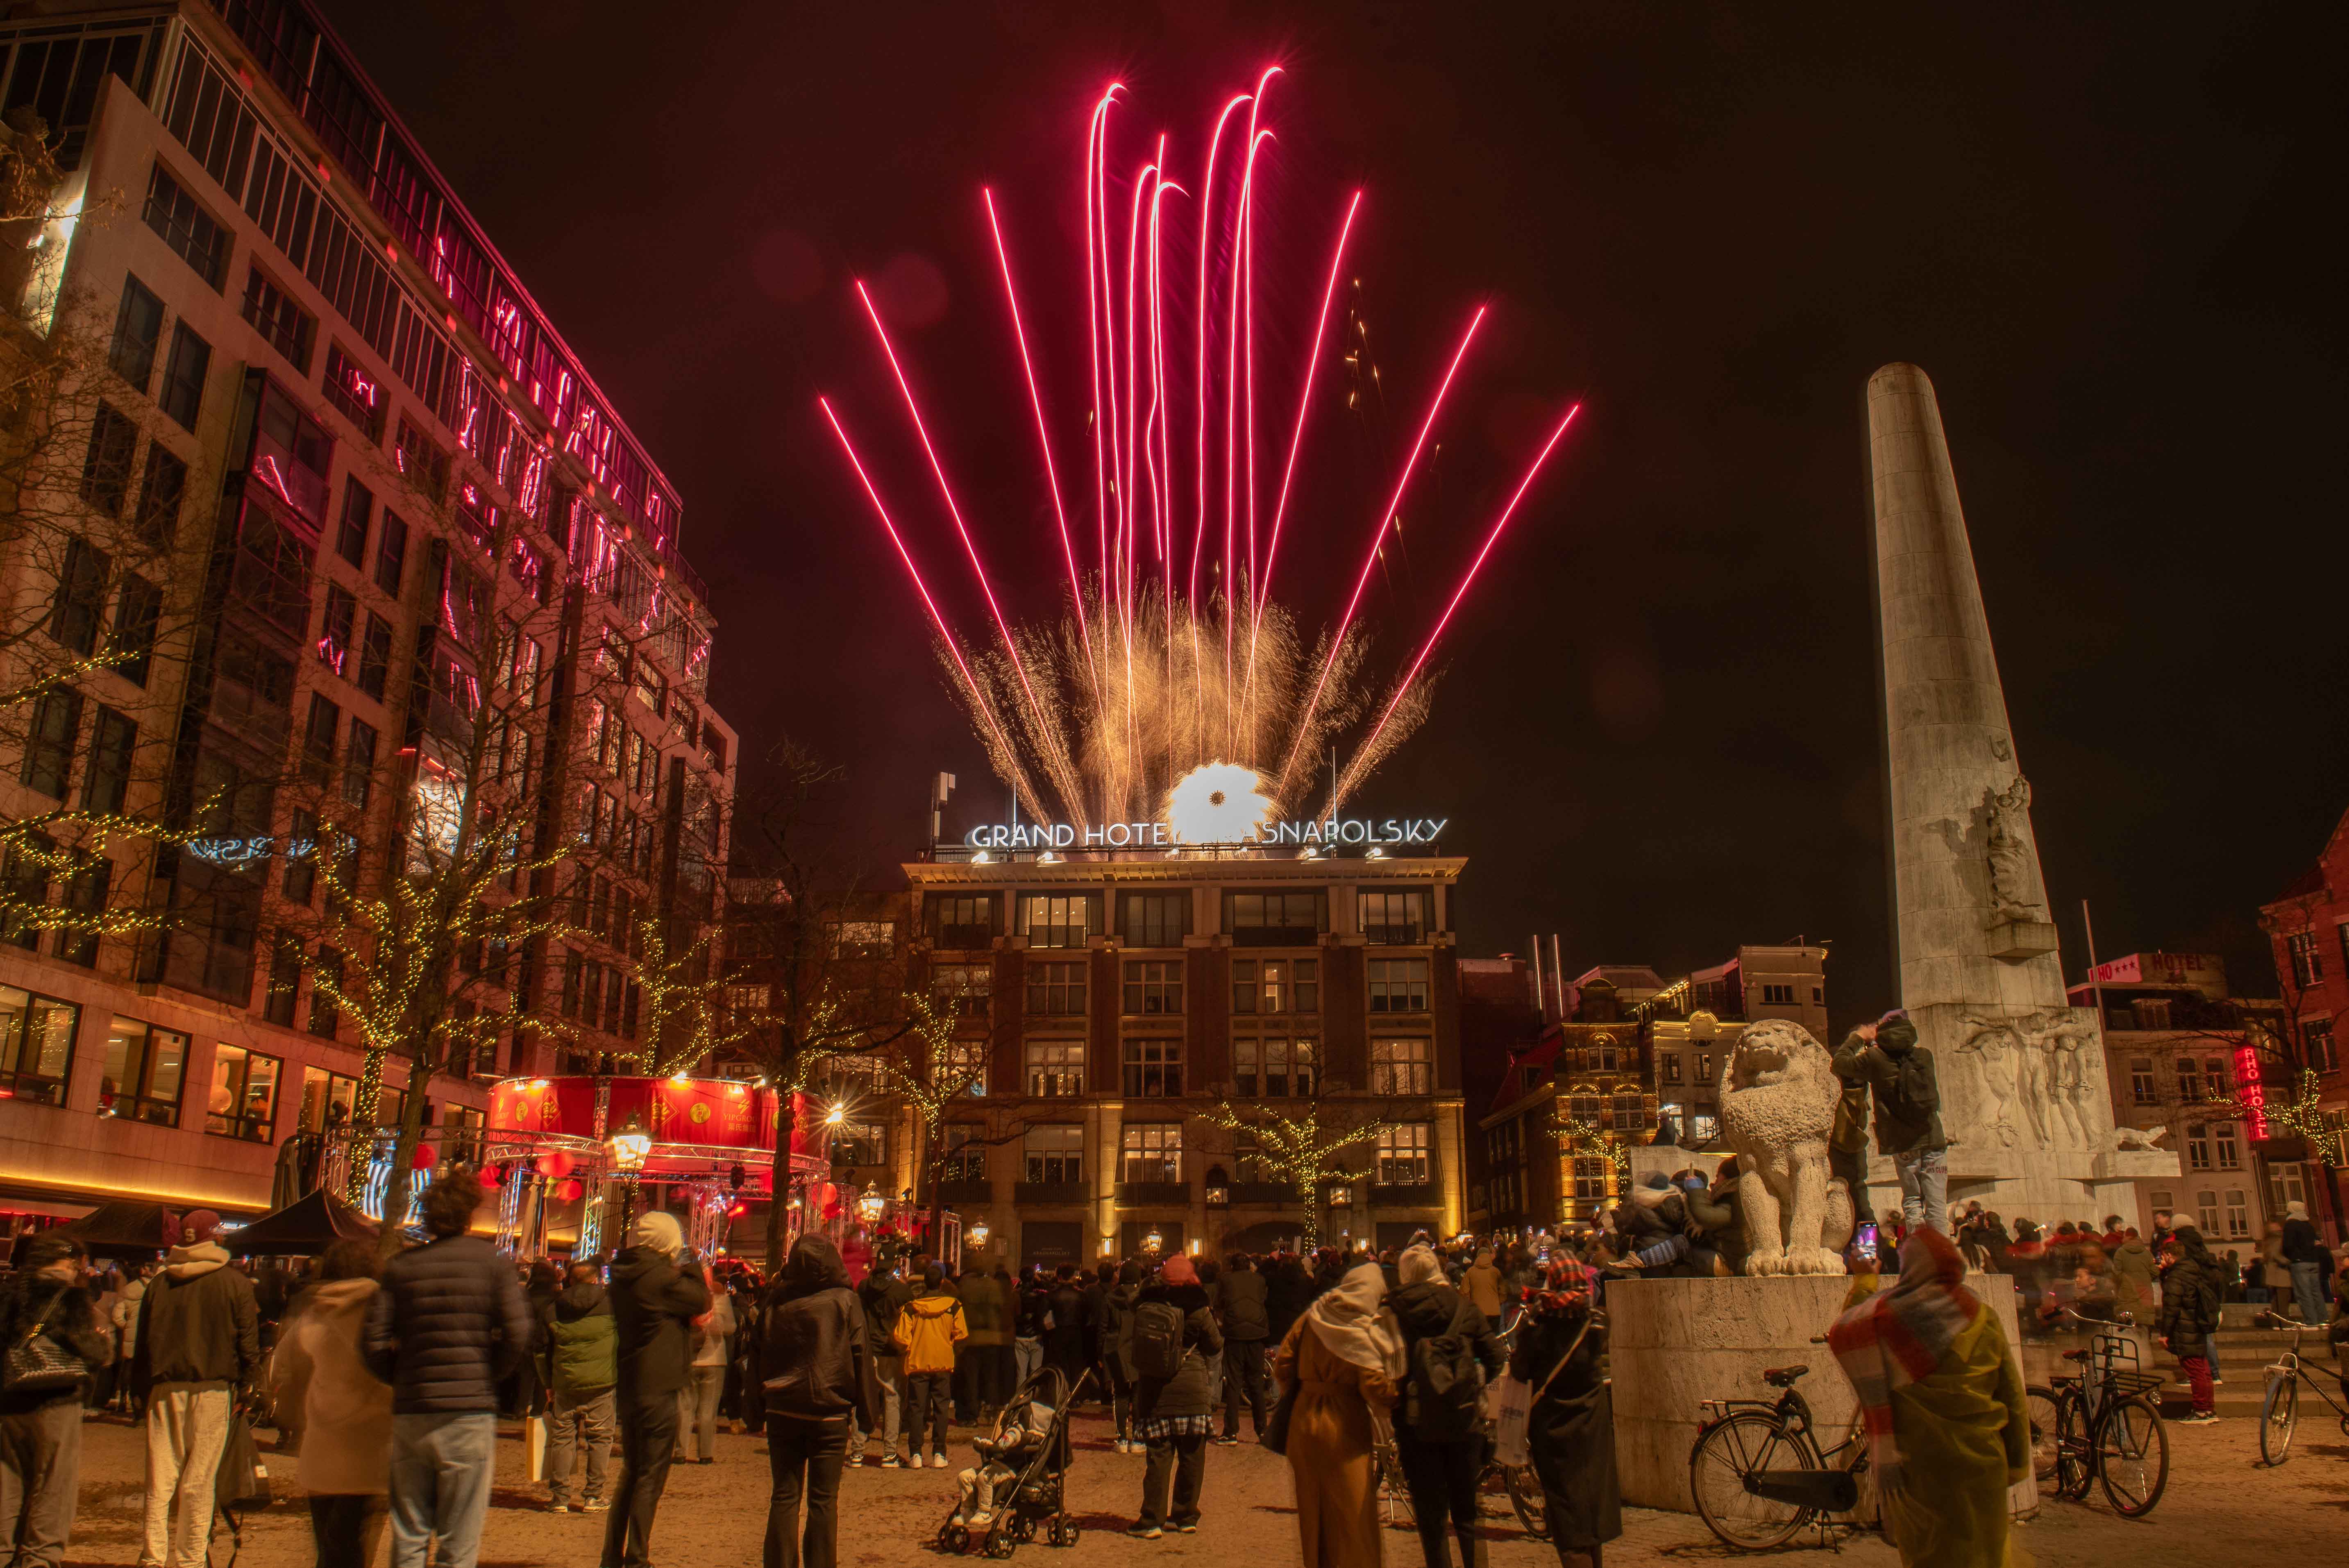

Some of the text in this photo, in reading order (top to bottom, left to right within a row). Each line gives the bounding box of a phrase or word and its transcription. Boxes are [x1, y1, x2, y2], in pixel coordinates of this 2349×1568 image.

[972, 824, 1074, 846] GRAND
[2152, 954, 2206, 971] HOTEL
[2245, 1048, 2258, 1080] RHO
[724, 1113, 762, 1123] YIPGROU
[184, 1228, 195, 1242] S
